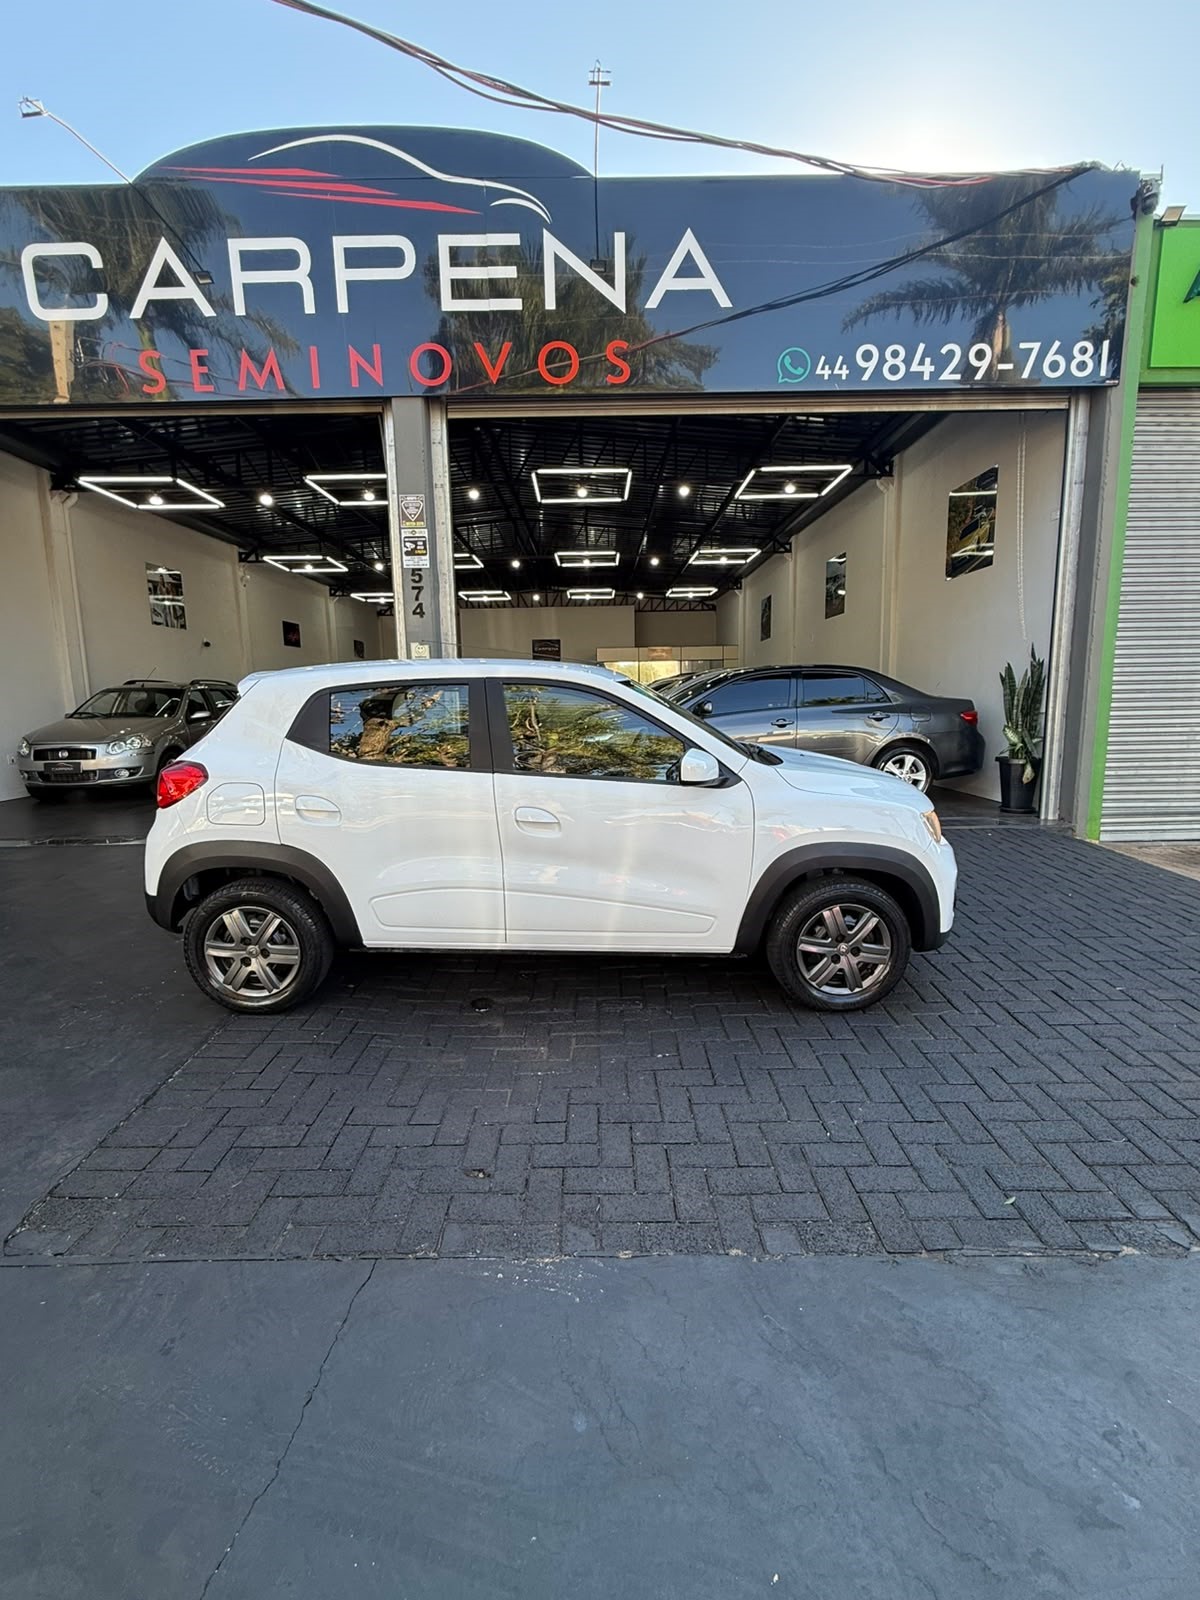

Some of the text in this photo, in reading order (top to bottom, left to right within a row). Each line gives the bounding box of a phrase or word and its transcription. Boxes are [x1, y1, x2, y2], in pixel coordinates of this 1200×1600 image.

[21, 227, 733, 321] CARPENA
[139, 340, 631, 394] SEMINOVOS
[815, 339, 1109, 382] 44 98429-7681
[410, 568, 424, 618] 574
